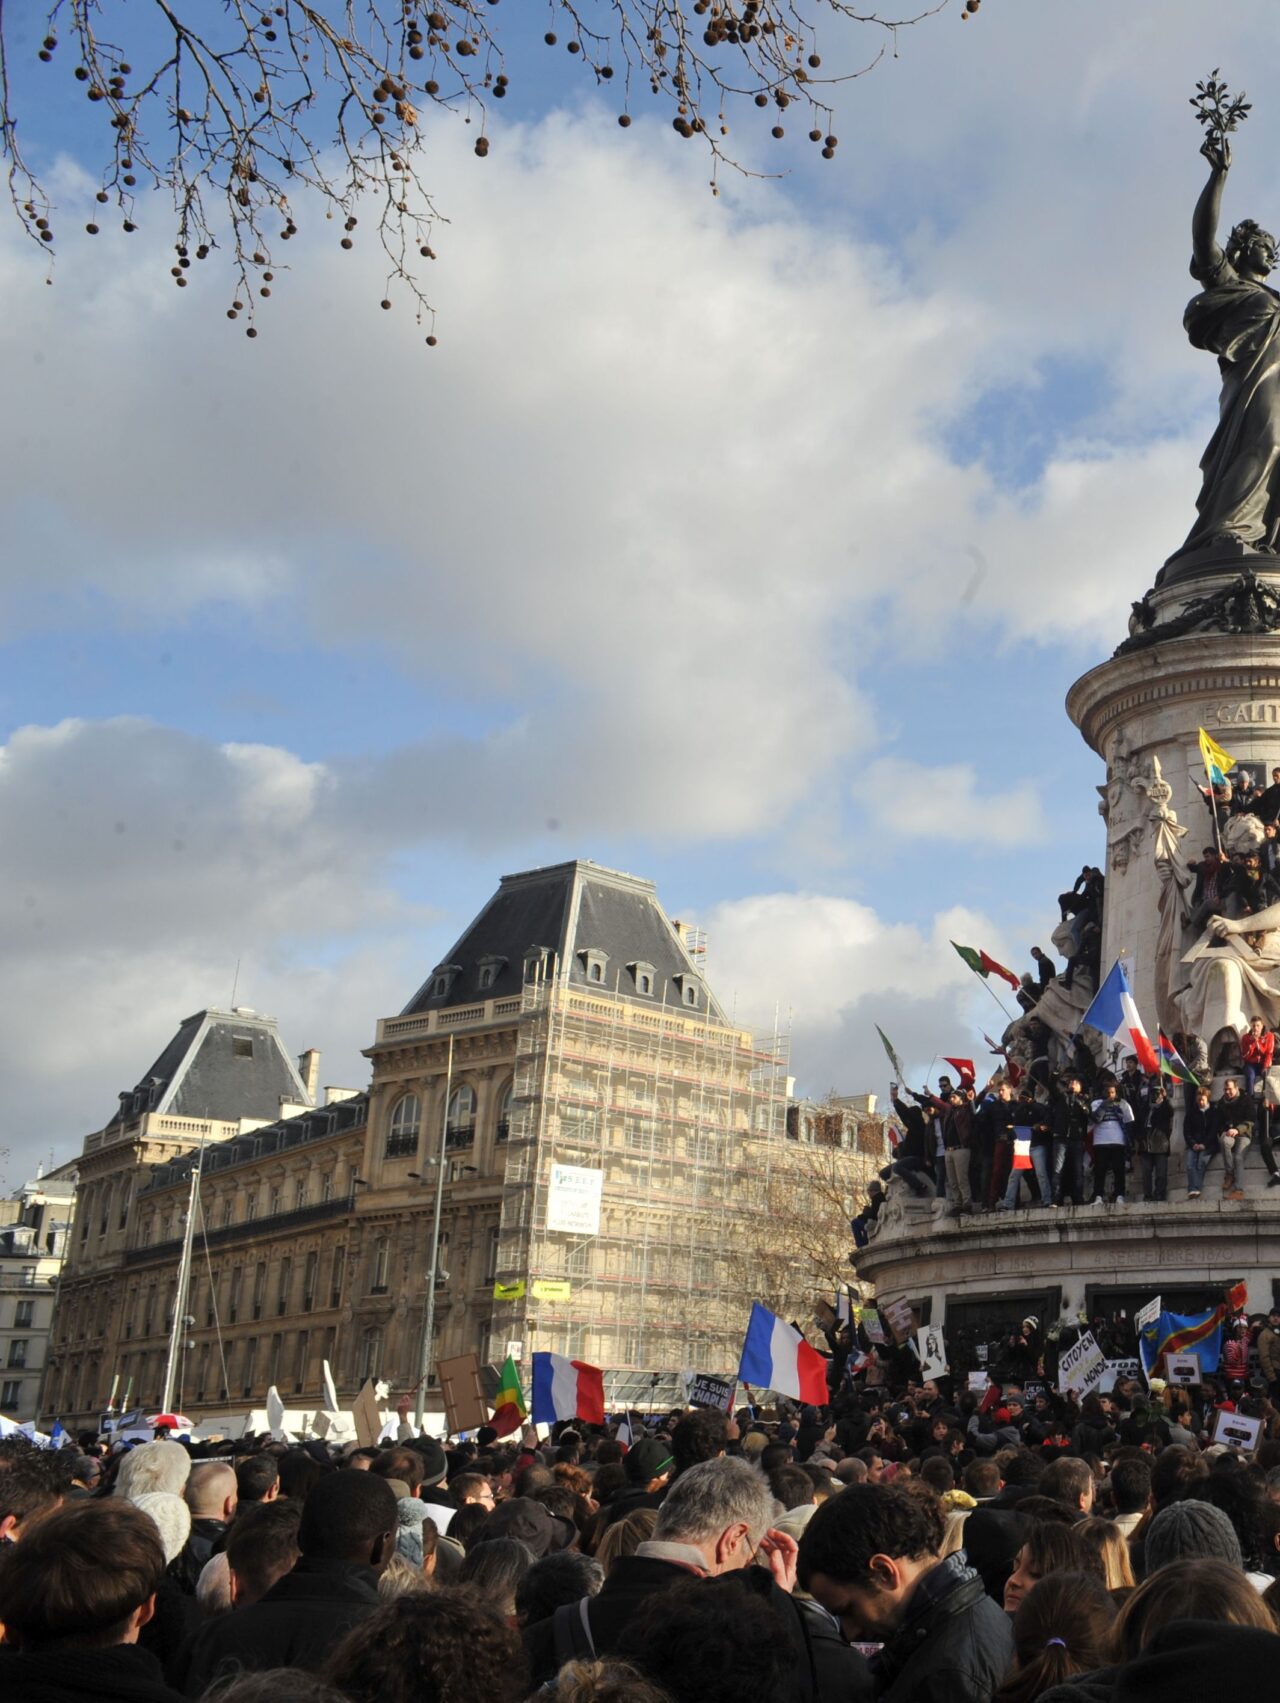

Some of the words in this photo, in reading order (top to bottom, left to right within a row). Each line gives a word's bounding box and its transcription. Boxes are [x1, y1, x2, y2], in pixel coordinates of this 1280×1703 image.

[1108, 1248, 1195, 1265] SEPTEMBRE
[1201, 1247, 1234, 1262] 1870
[1061, 1333, 1095, 1372] CITOYEN
[1083, 1358, 1110, 1387] MONDE
[695, 1379, 709, 1390] JE
[709, 1382, 729, 1398] SUIS
